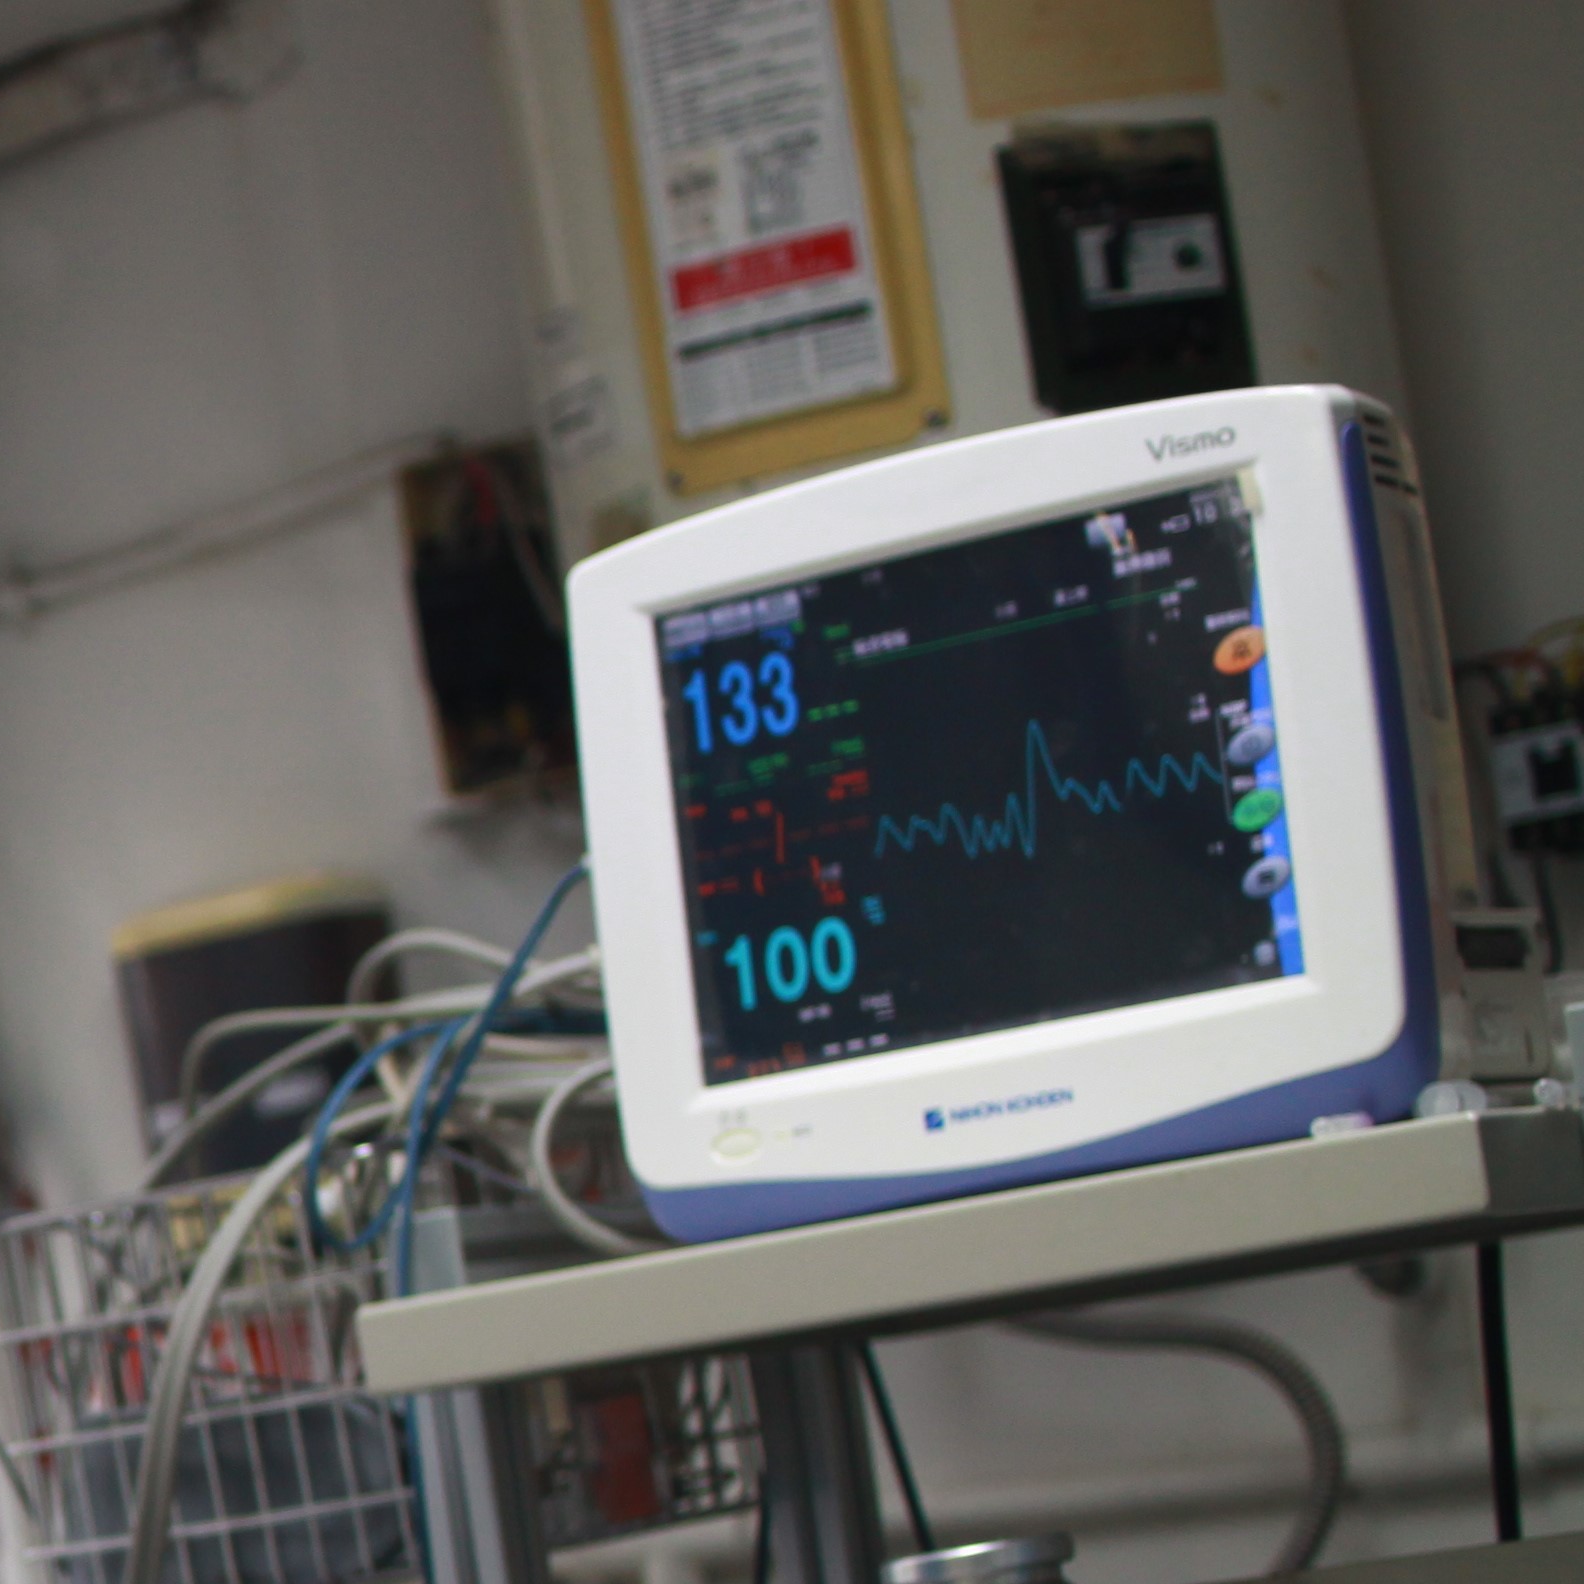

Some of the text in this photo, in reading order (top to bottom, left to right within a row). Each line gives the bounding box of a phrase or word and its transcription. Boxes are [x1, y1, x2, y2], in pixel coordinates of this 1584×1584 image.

[1144, 426, 1237, 462] Vismo
[683, 651, 801, 756] 133
[724, 915, 858, 1012] 100
